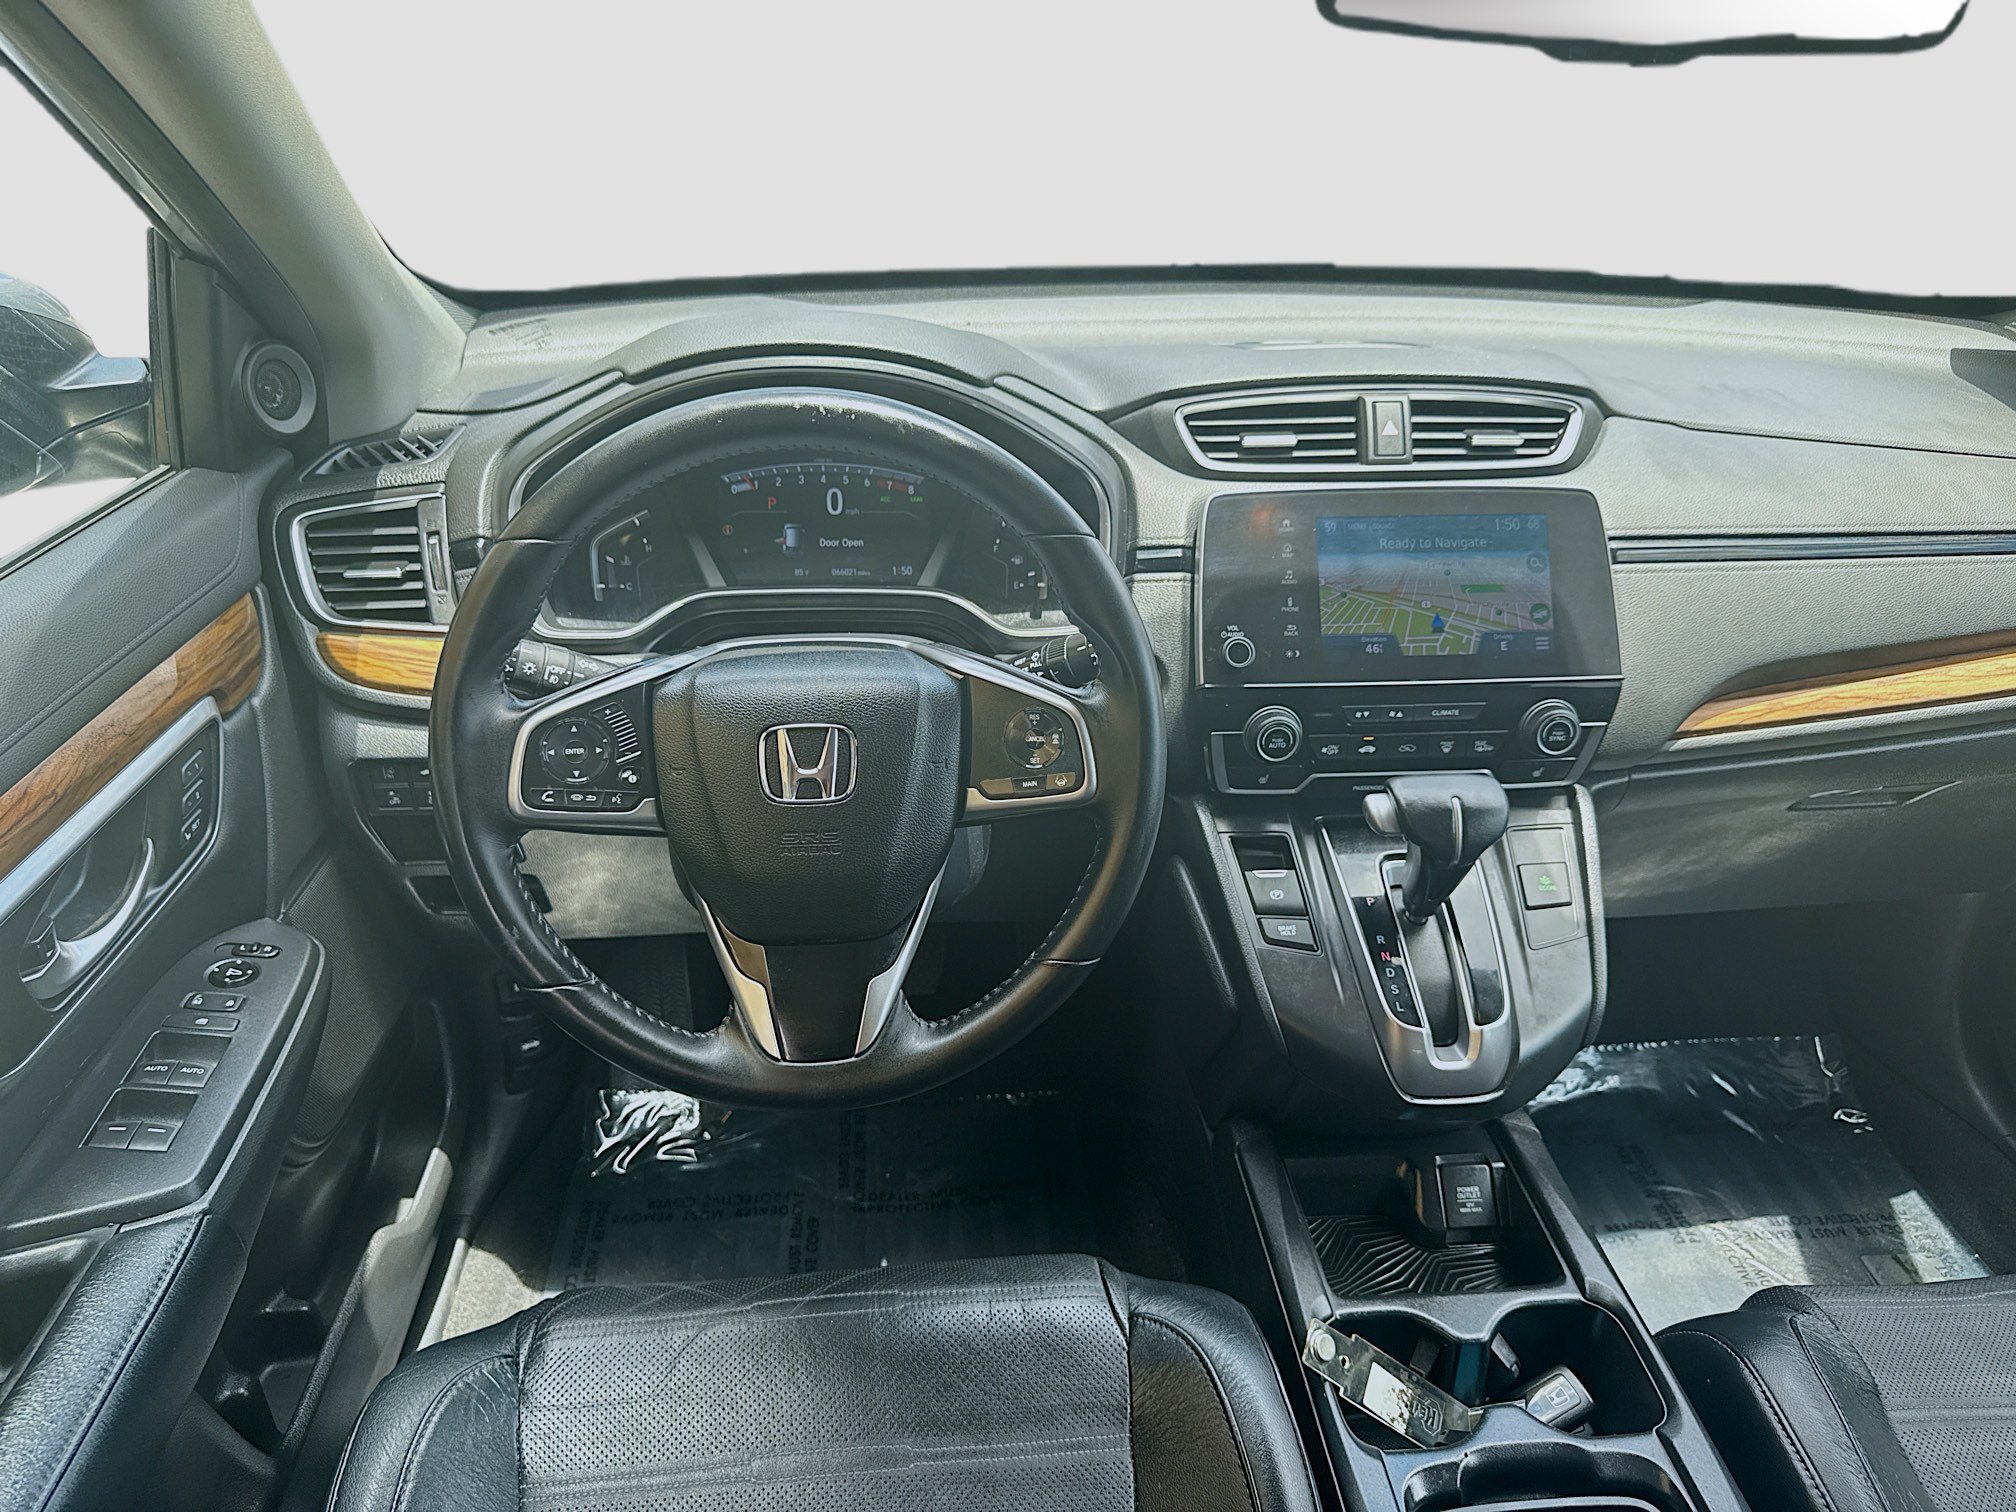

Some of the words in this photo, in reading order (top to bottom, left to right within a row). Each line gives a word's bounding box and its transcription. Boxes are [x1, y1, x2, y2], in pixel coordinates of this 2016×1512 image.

[767, 496, 777, 510] P
[826, 487, 843, 516] 0
[1495, 517, 1520, 531] 1:50
[819, 537, 840, 548] Door
[842, 537, 864, 549] Open
[1379, 537, 1416, 552] Ready
[1420, 539, 1432, 549] to
[1435, 537, 1487, 551] Navigate
[892, 565, 913, 576] 1:50
[564, 747, 585, 755] ENTER
[1022, 780, 1038, 788] MAIN
[781, 832, 839, 844] SRS
[780, 845, 842, 856] AIRBAG
[1376, 935, 1386, 945] R
[1381, 951, 1391, 961] N
[1386, 967, 1395, 978] D
[1390, 984, 1399, 995] S
[180, 1067, 205, 1075] AUTO
